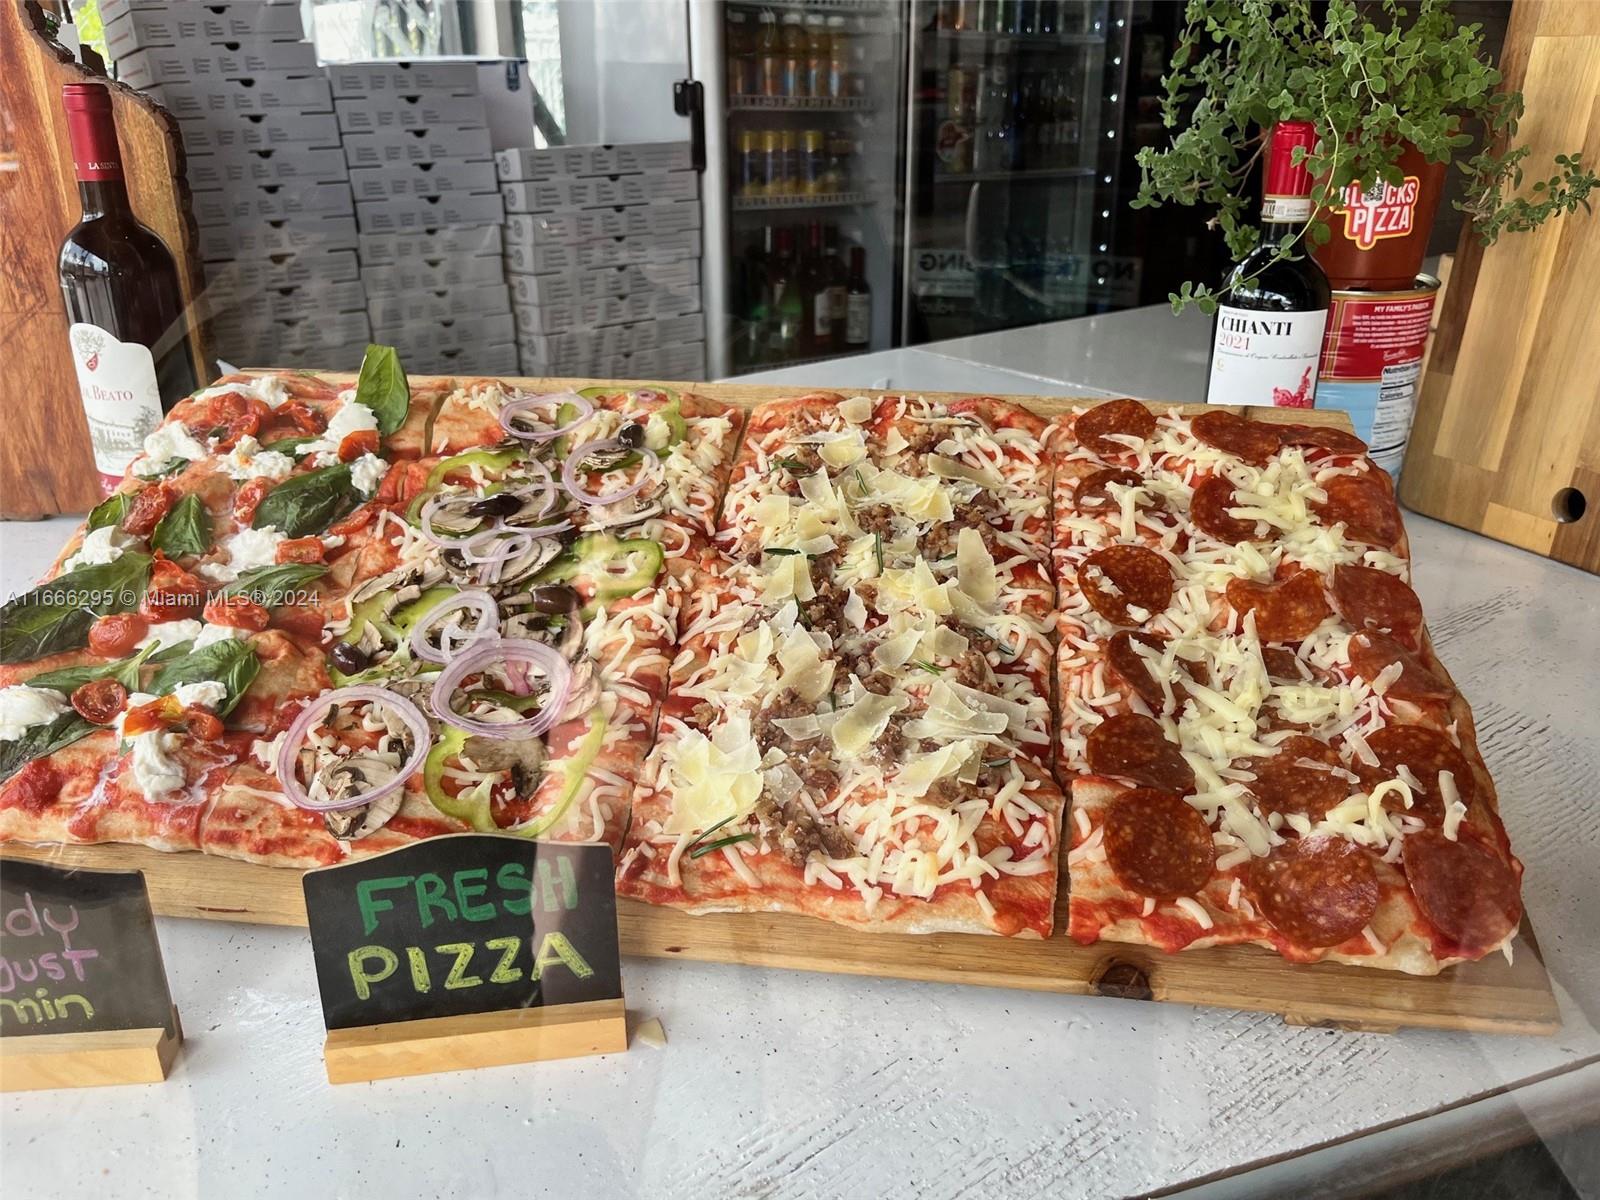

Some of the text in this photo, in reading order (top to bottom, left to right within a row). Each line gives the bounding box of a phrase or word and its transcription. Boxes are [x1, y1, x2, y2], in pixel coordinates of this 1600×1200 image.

[1352, 205, 1410, 243] PIZZA
[1221, 316, 1293, 336] CHIANTI
[0, 892, 79, 952] dy
[356, 856, 578, 936] FRESH
[347, 931, 594, 1000] PIZZA
